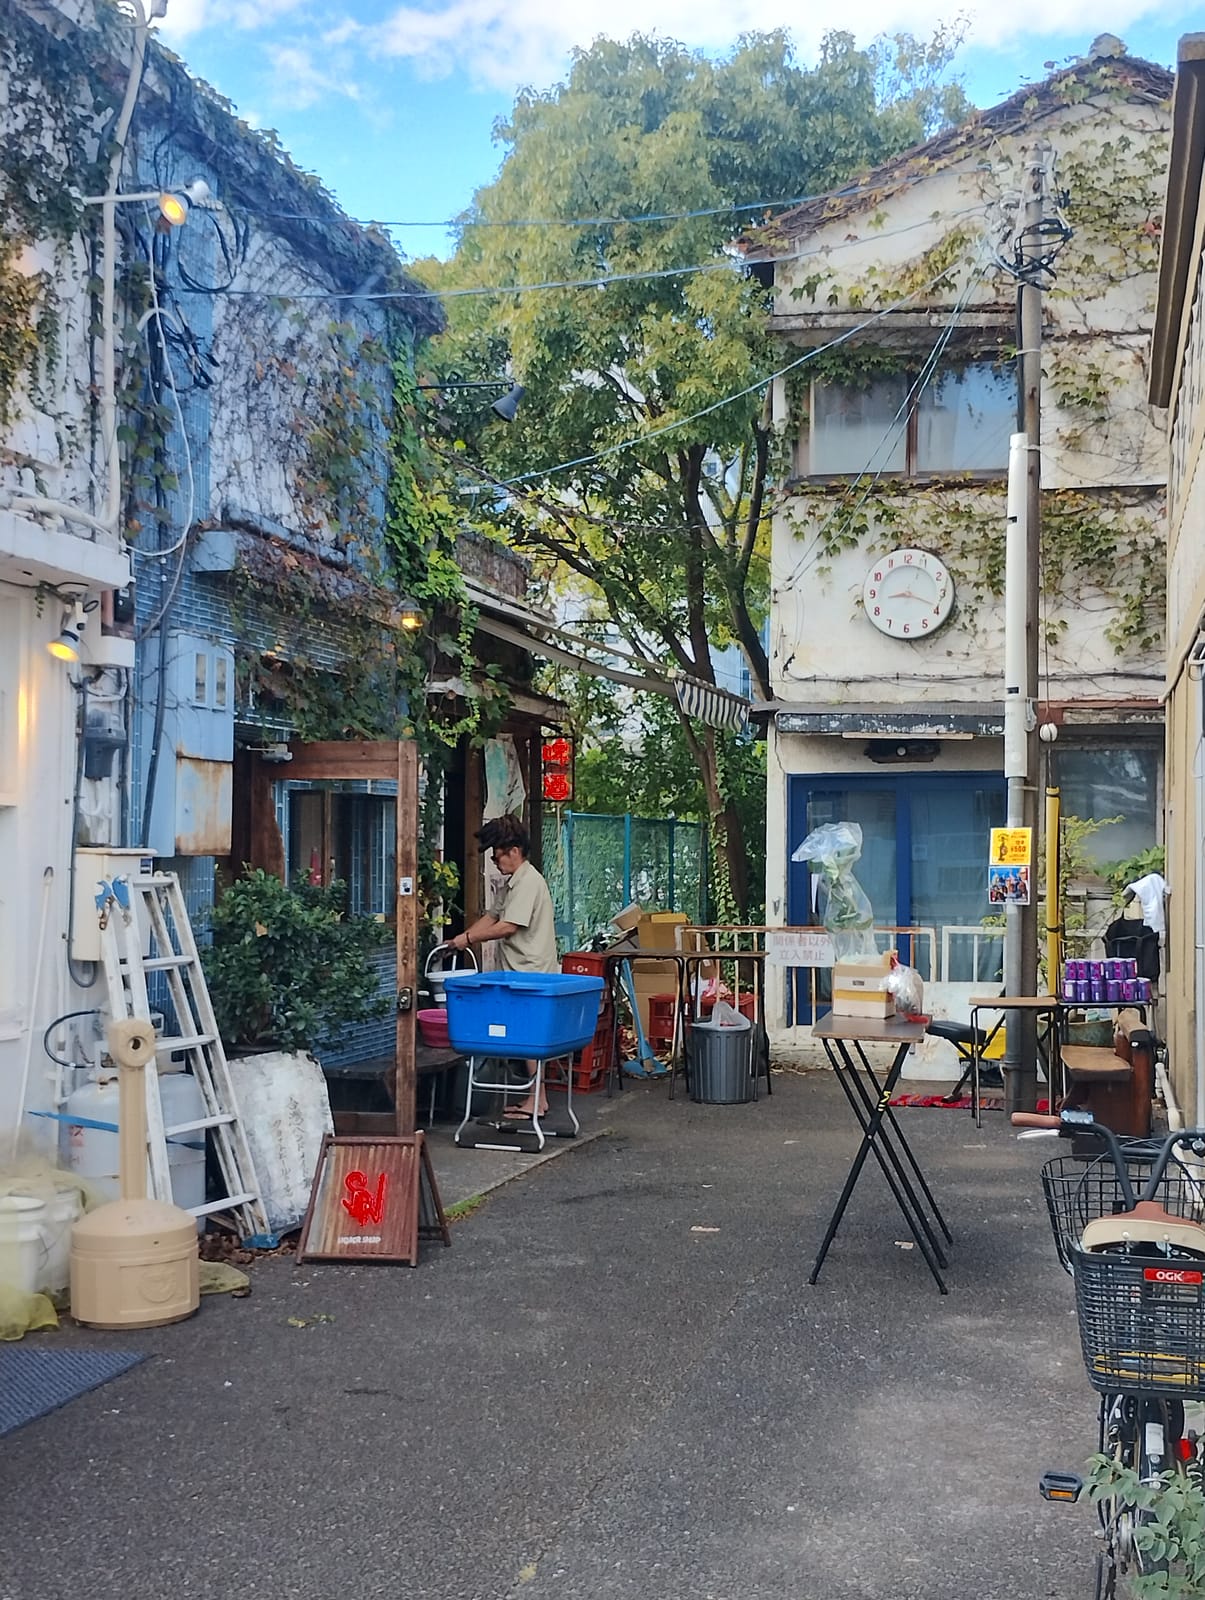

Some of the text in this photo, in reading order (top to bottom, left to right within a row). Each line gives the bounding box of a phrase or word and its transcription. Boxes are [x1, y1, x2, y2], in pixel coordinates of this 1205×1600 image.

[888, 559, 894, 569] 11
[904, 554, 913, 564] 12
[874, 572, 882, 582] 10
[935, 571, 942, 582] 2
[870, 589, 876, 599] 9
[940, 589, 946, 598] 3
[874, 606, 881, 616] 8
[933, 606, 940, 616] 4
[886, 619, 892, 629] 7
[903, 624, 910, 633] 6
[922, 619, 928, 629] 5
[542, 738, 569, 800] 啤酒
[778, 950, 825, 961] 立入禁止
[1156, 1271, 1185, 1282] OGK
